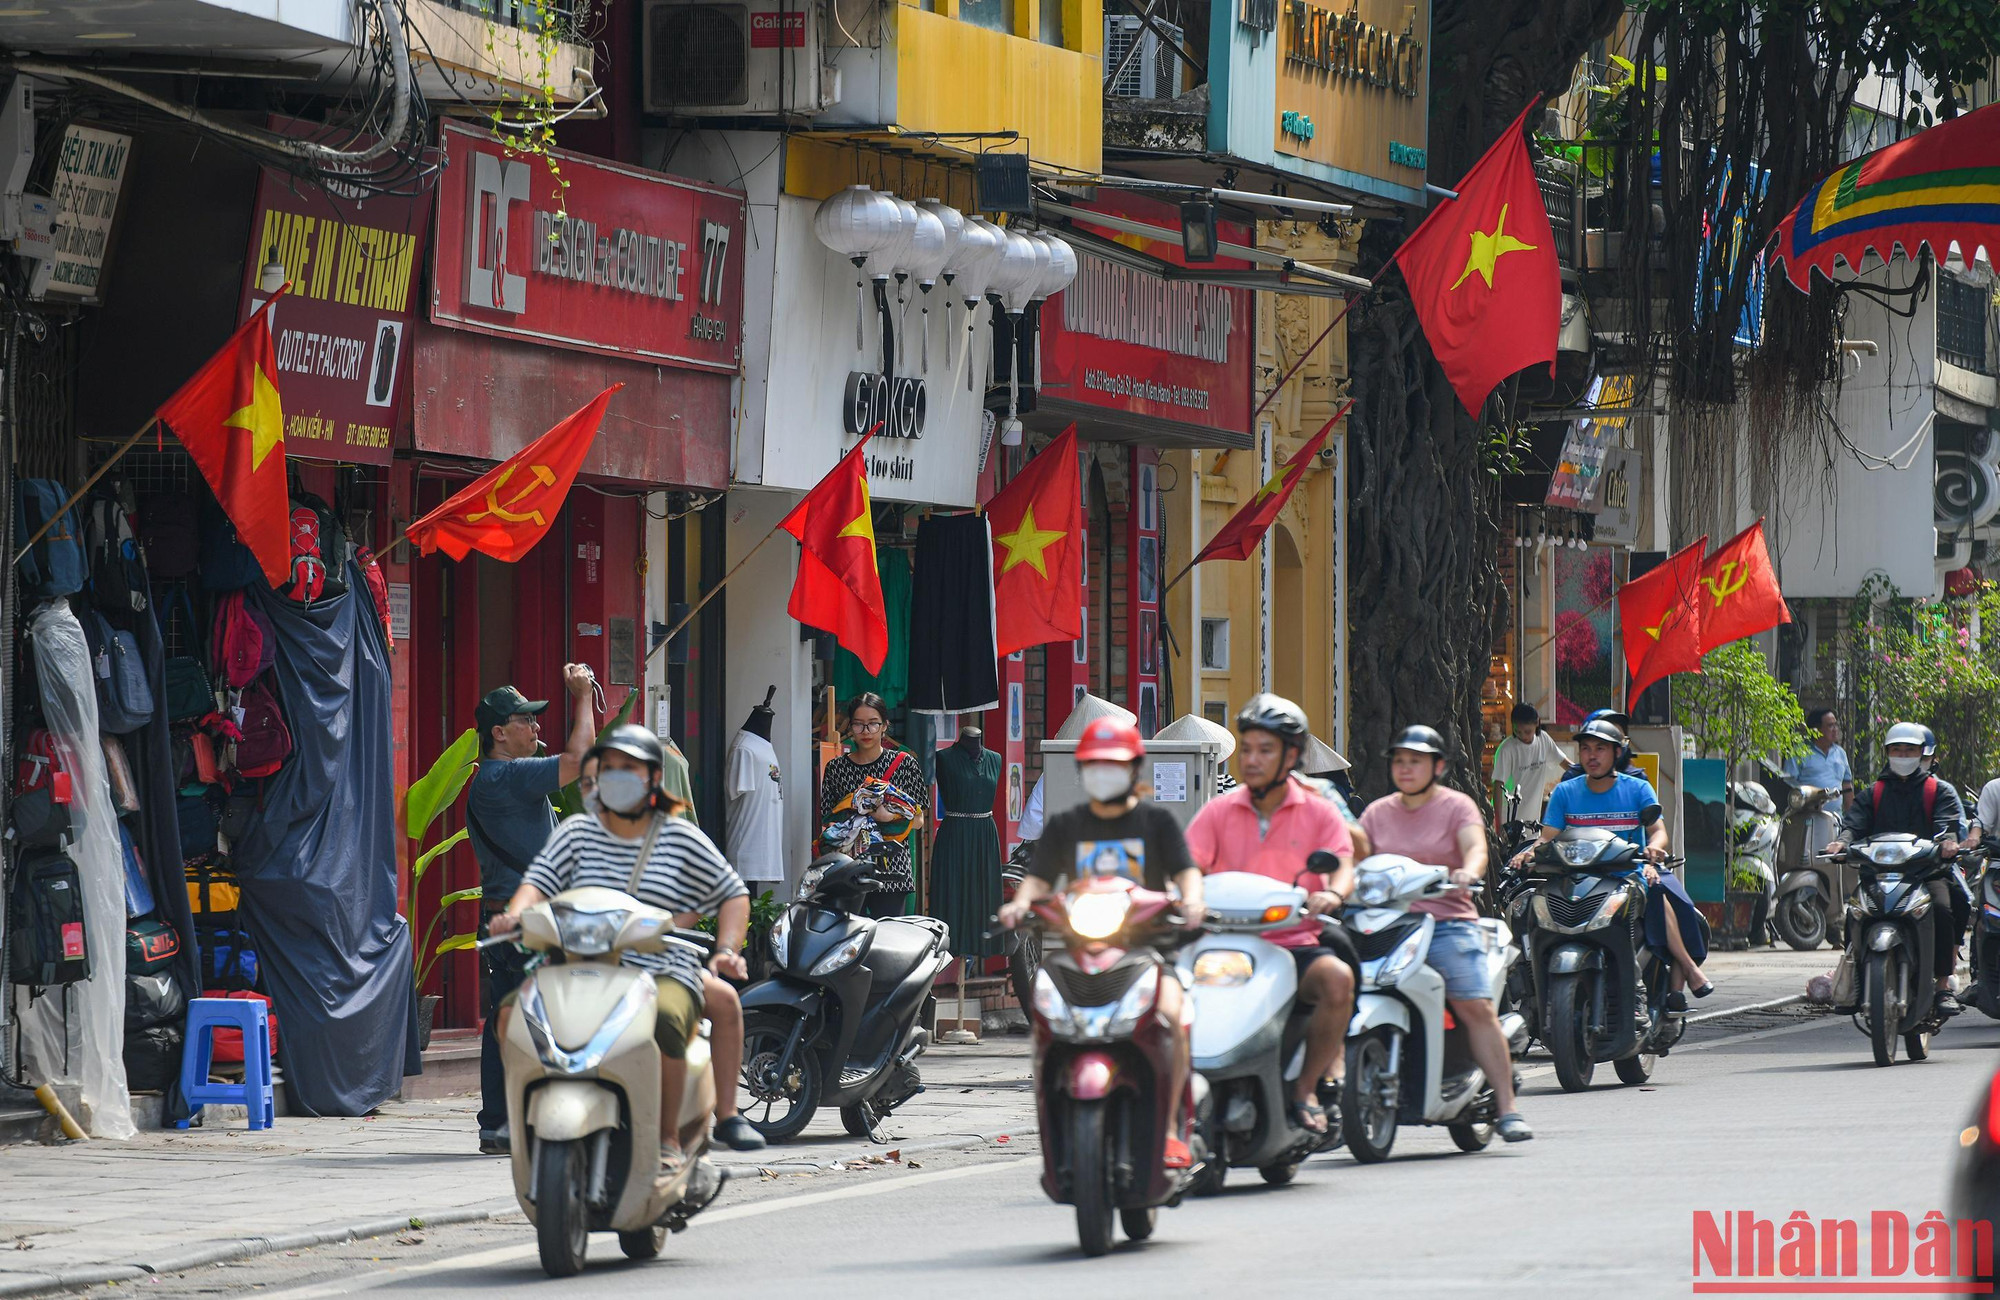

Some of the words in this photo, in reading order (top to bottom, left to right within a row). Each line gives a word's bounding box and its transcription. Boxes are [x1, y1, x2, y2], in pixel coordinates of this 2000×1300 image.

[753, 15, 803, 29] Galanz
[309, 219, 339, 300] IN
[335, 224, 416, 313] VIETNAM
[535, 210, 597, 282] DESIGN
[613, 228, 686, 302] COUTURE
[702, 218, 730, 307] 77
[1064, 251, 1128, 342] OUTDOOR
[1129, 271, 1200, 359] ADVENTURE
[1201, 284, 1232, 364] SHOP
[277, 328, 320, 375] OUTLET
[316, 334, 366, 381] FACTORY
[1103, 370, 1116, 398] Hang
[1116, 373, 1126, 395] Gai
[1132, 377, 1145, 398] Hoan
[289, 409, 308, 438] HOÀN
[324, 419, 335, 441] HN
[871, 454, 888, 477] too
[890, 456, 914, 481] shirt
